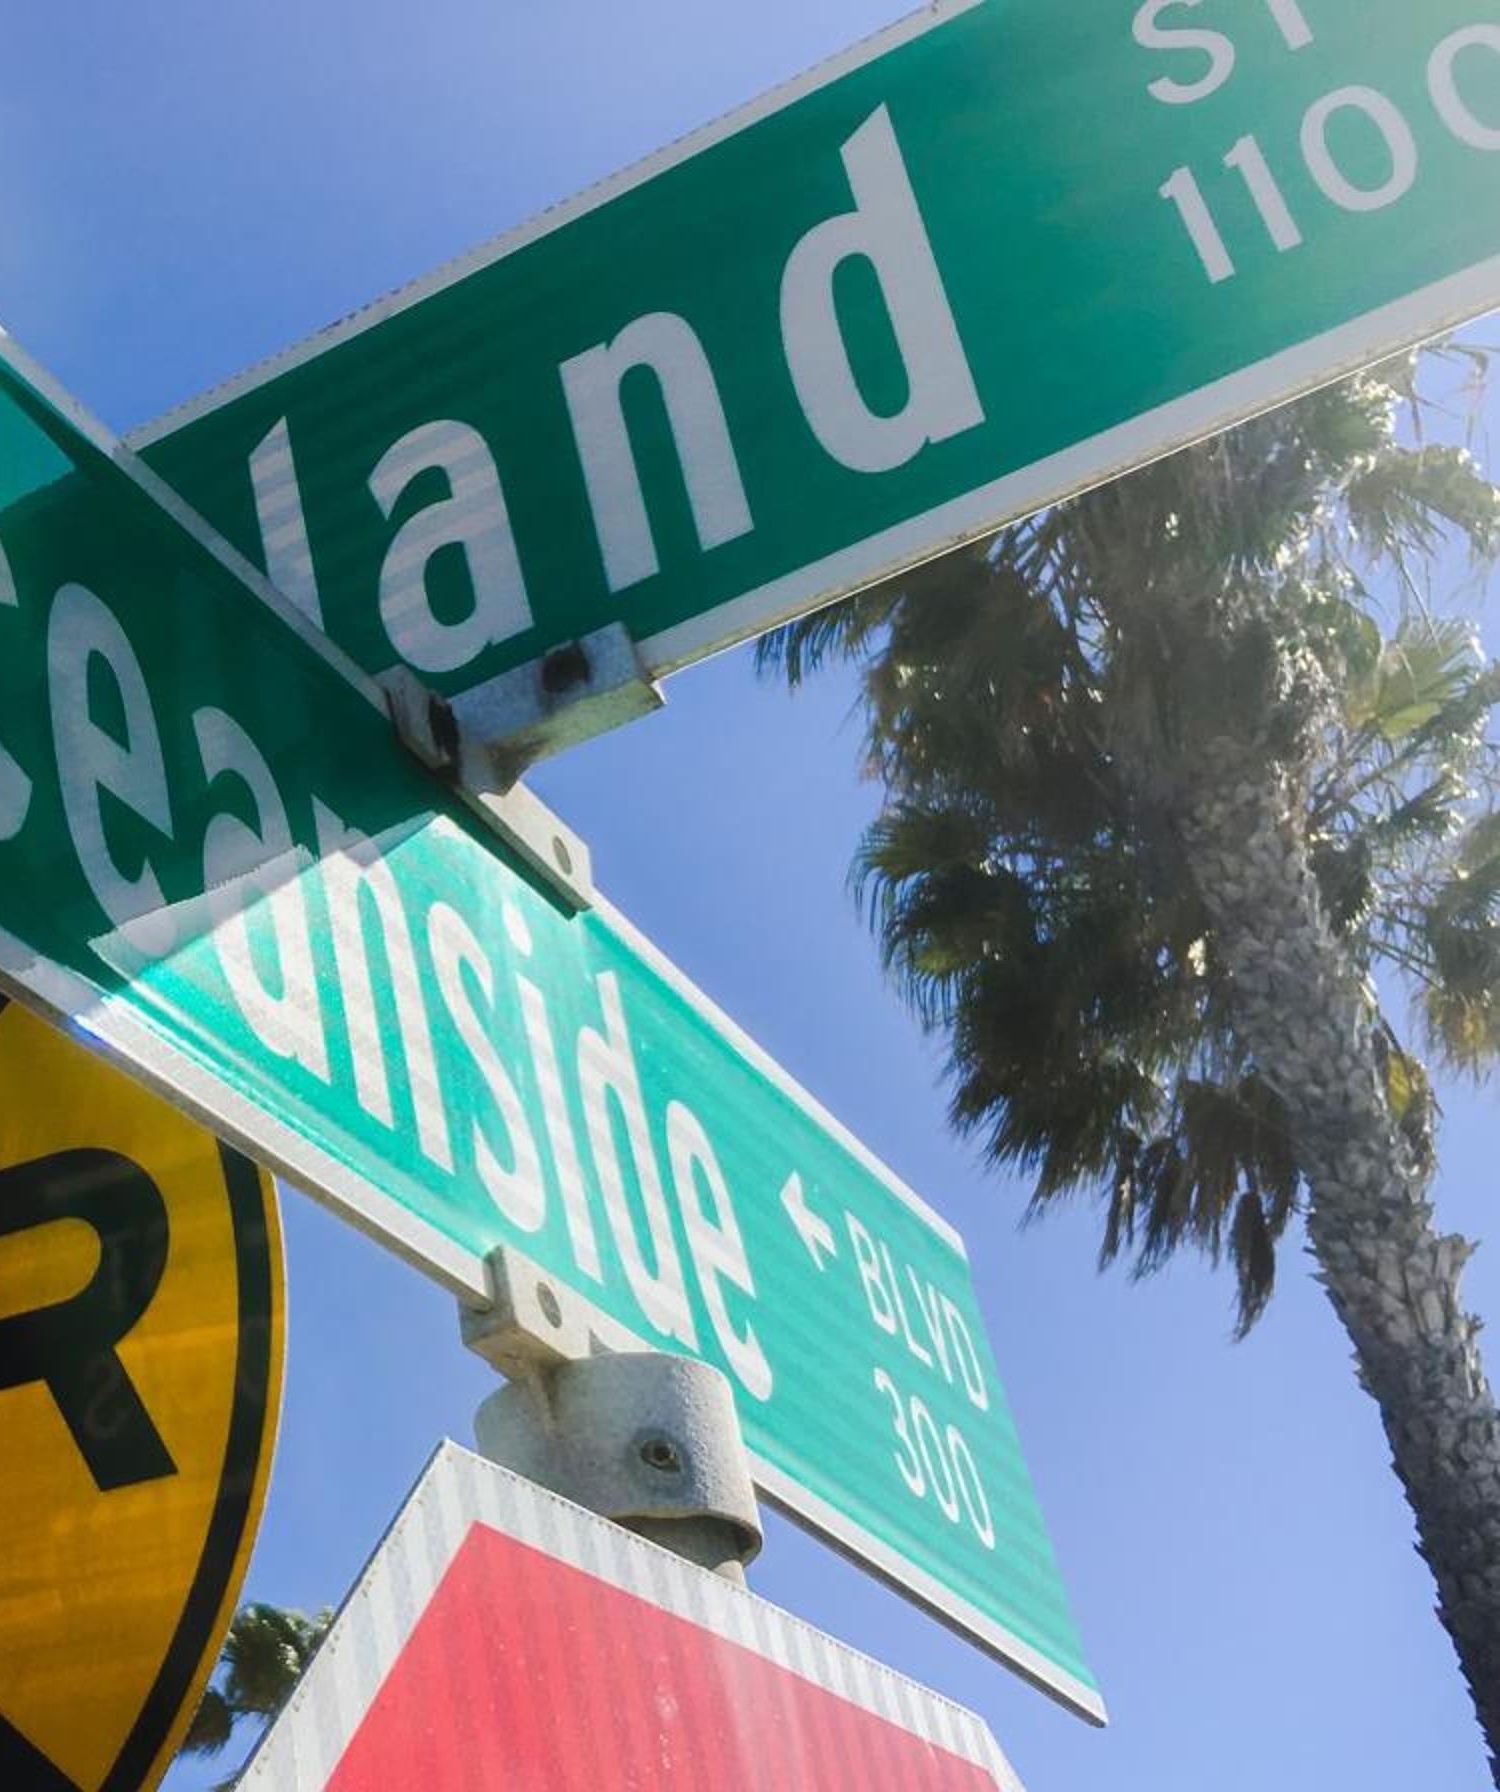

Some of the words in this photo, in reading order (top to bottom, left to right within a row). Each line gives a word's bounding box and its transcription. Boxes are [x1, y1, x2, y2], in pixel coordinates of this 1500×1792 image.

[1159, 24, 1500, 283] 1100
[846, 1210, 990, 1411] BLVD
[874, 1368, 995, 1551] 300
